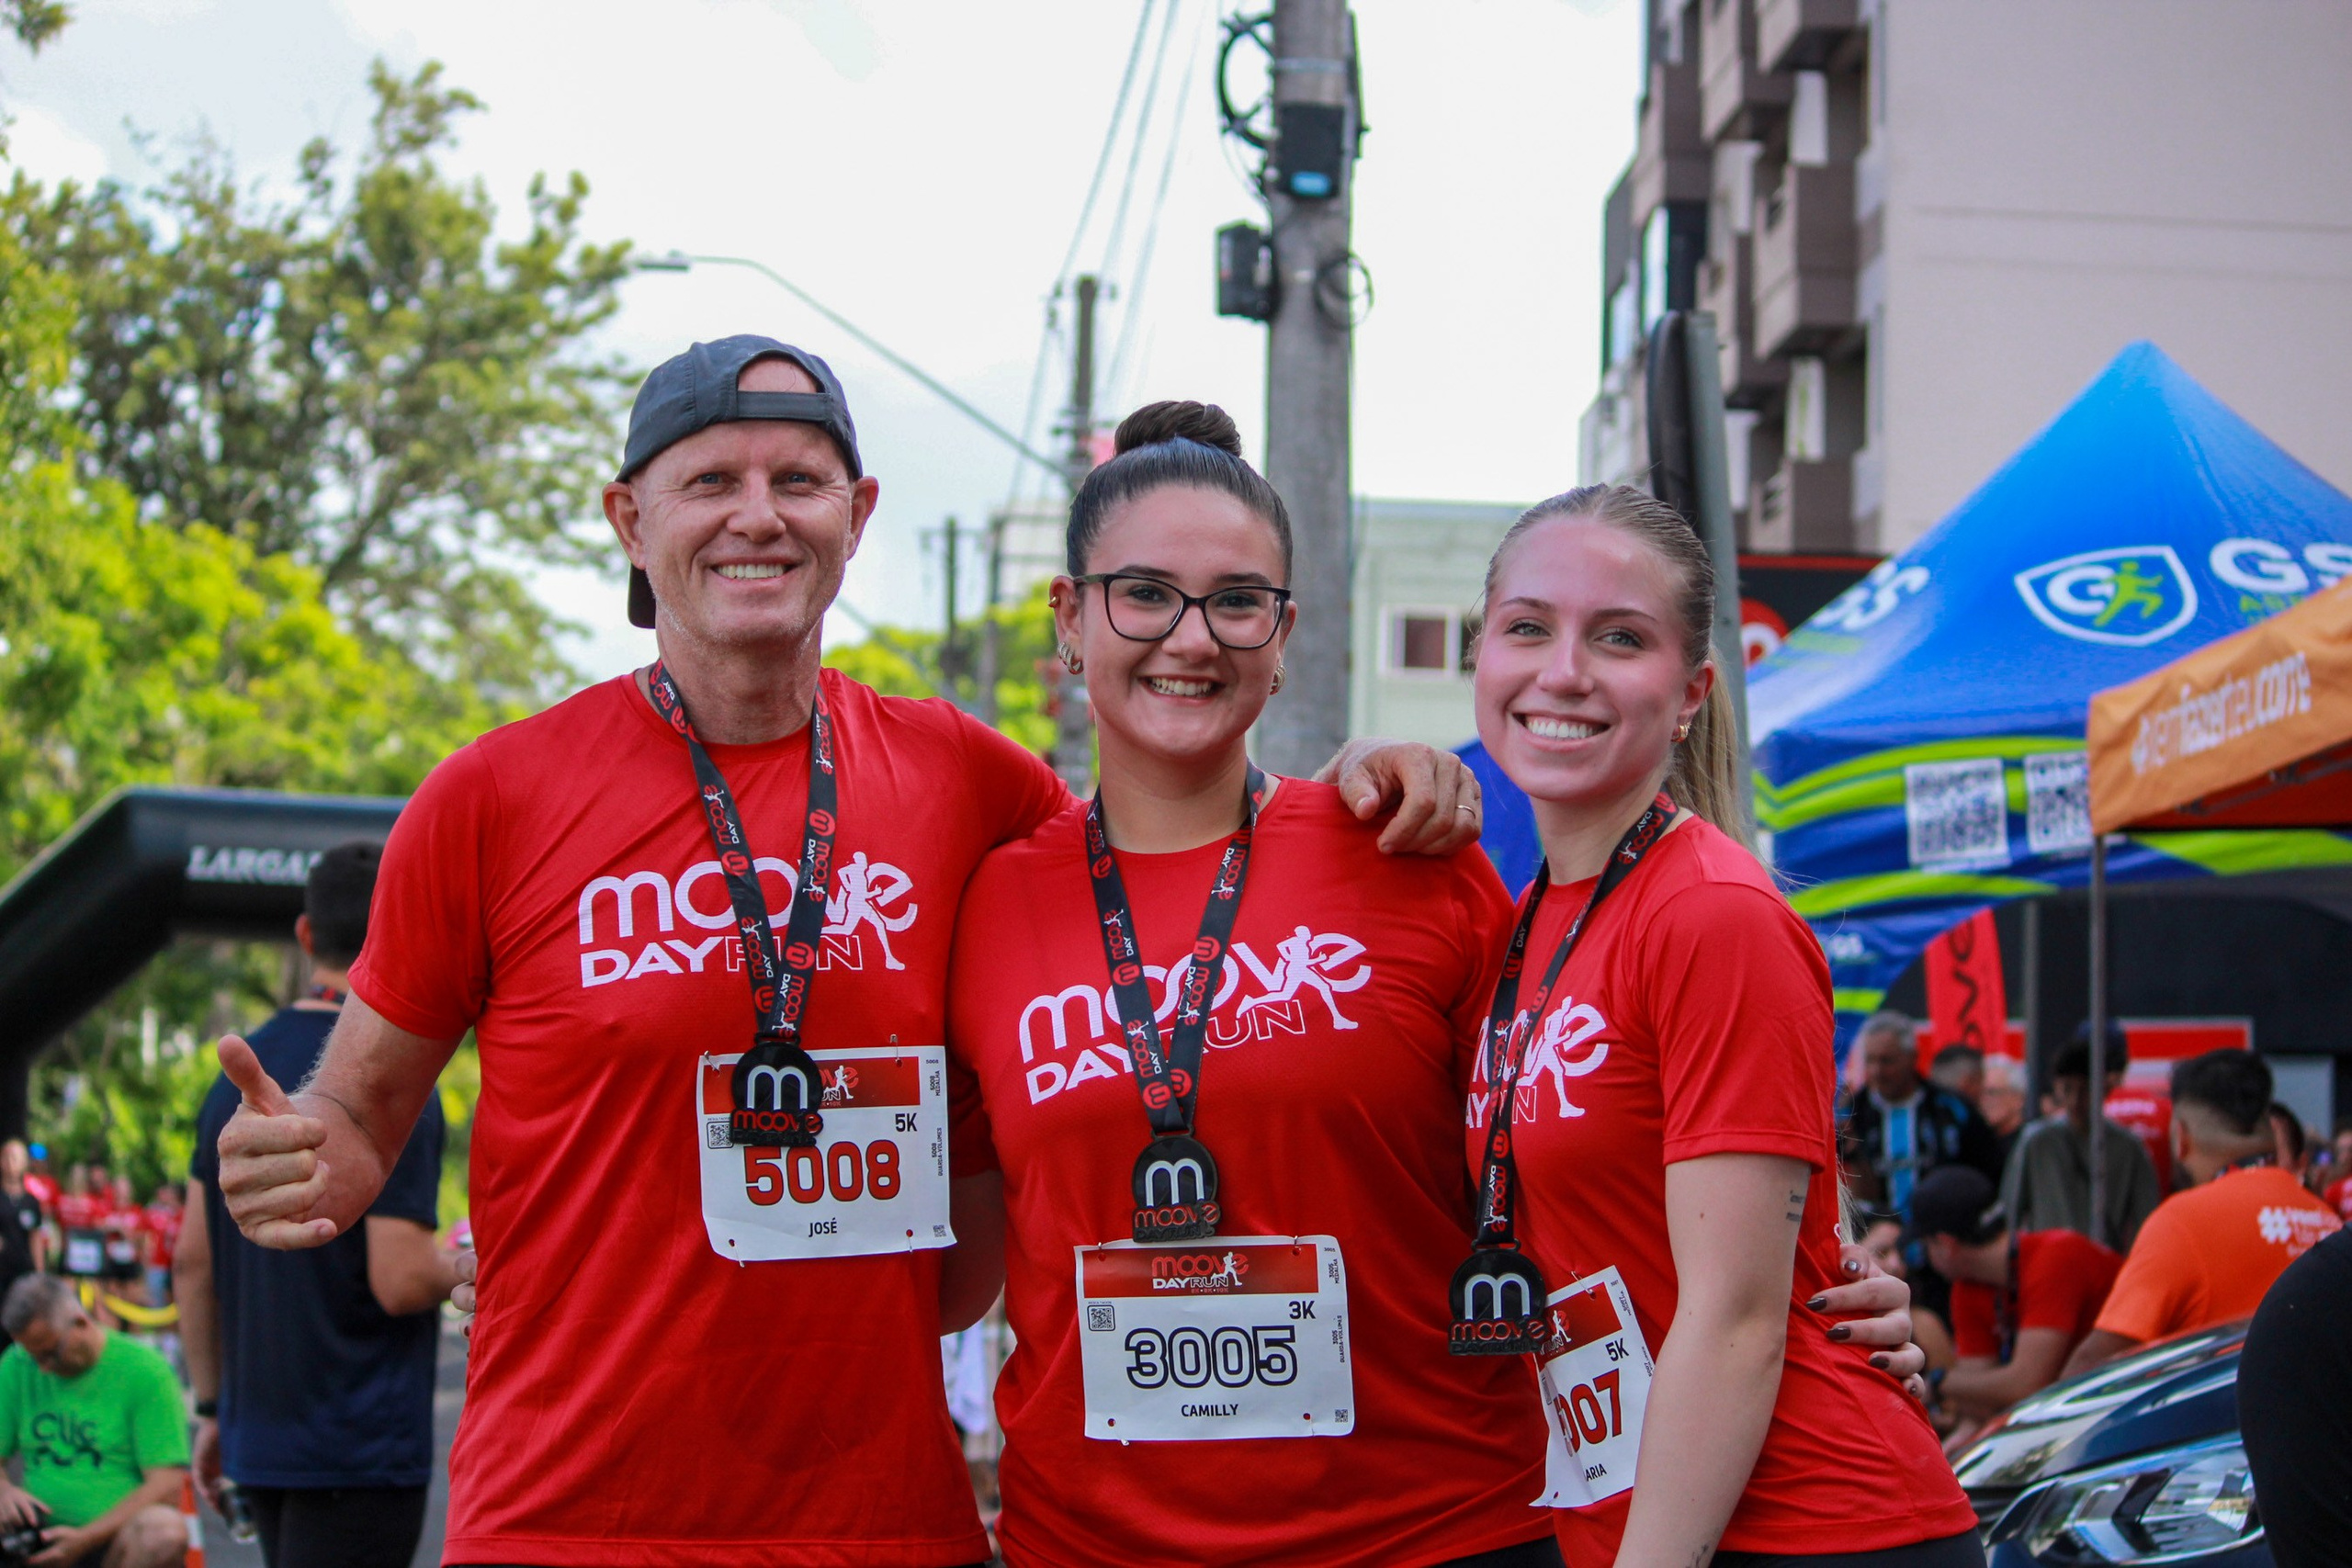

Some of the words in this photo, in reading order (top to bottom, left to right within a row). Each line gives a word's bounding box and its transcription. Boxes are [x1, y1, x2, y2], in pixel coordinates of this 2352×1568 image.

[1025, 998, 1306, 1105] DAYUN
[747, 1065, 808, 1111] m
[733, 1110, 821, 1134] moove
[895, 1113, 918, 1132] 5K
[744, 1139, 901, 1206] 5008
[1145, 1157, 1205, 1207] m
[808, 1217, 838, 1237] JOSÉ
[1151, 1253, 1250, 1277] moove
[1464, 1273, 1531, 1320] m
[1288, 1301, 1316, 1320] 3K
[1125, 1325, 1298, 1389] 3005
[1605, 1337, 1629, 1361] 5K
[1181, 1404, 1239, 1417] CAMILLY
